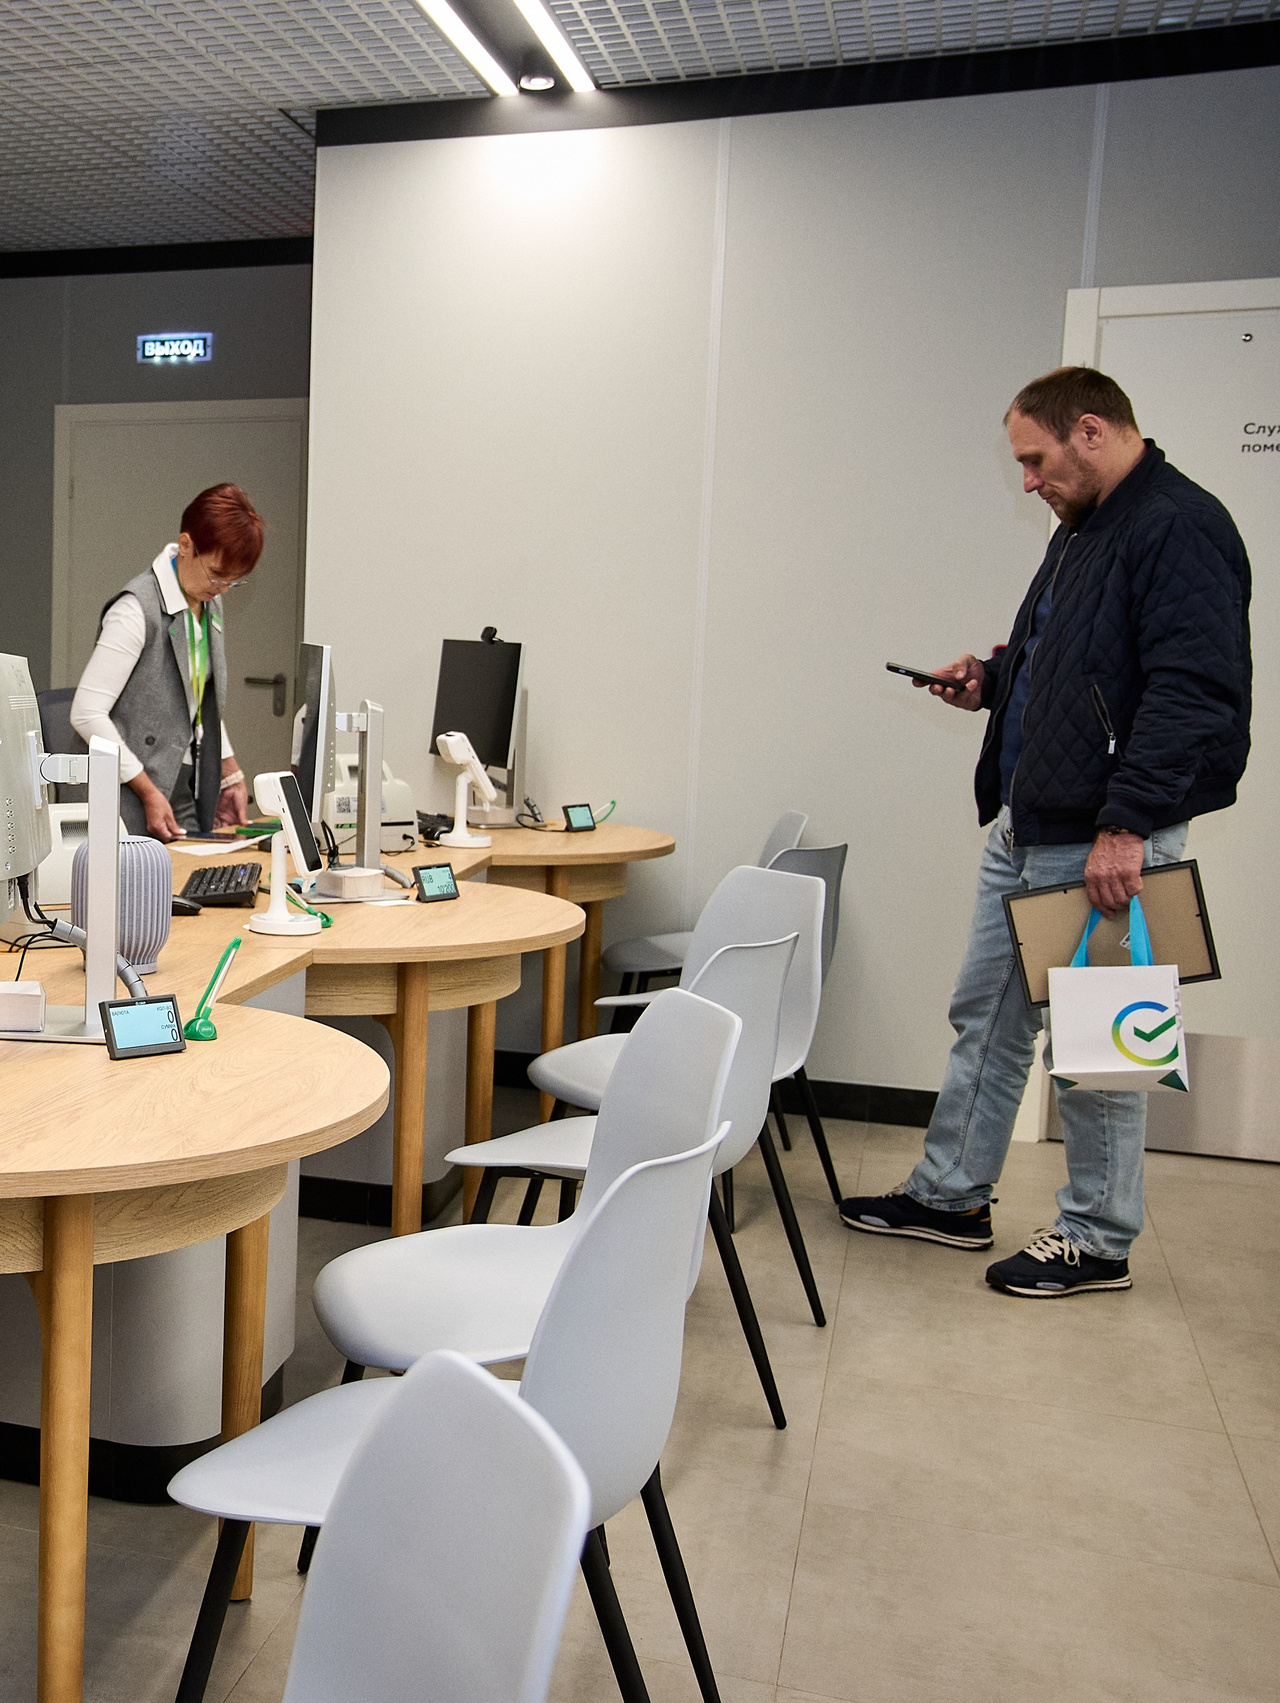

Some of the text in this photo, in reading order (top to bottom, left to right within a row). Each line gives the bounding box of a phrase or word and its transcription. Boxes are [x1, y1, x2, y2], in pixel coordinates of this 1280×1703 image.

[143, 339, 205, 357] ВЫХОД
[168, 1010, 175, 1023] 0
[171, 1028, 178, 1041] 0
